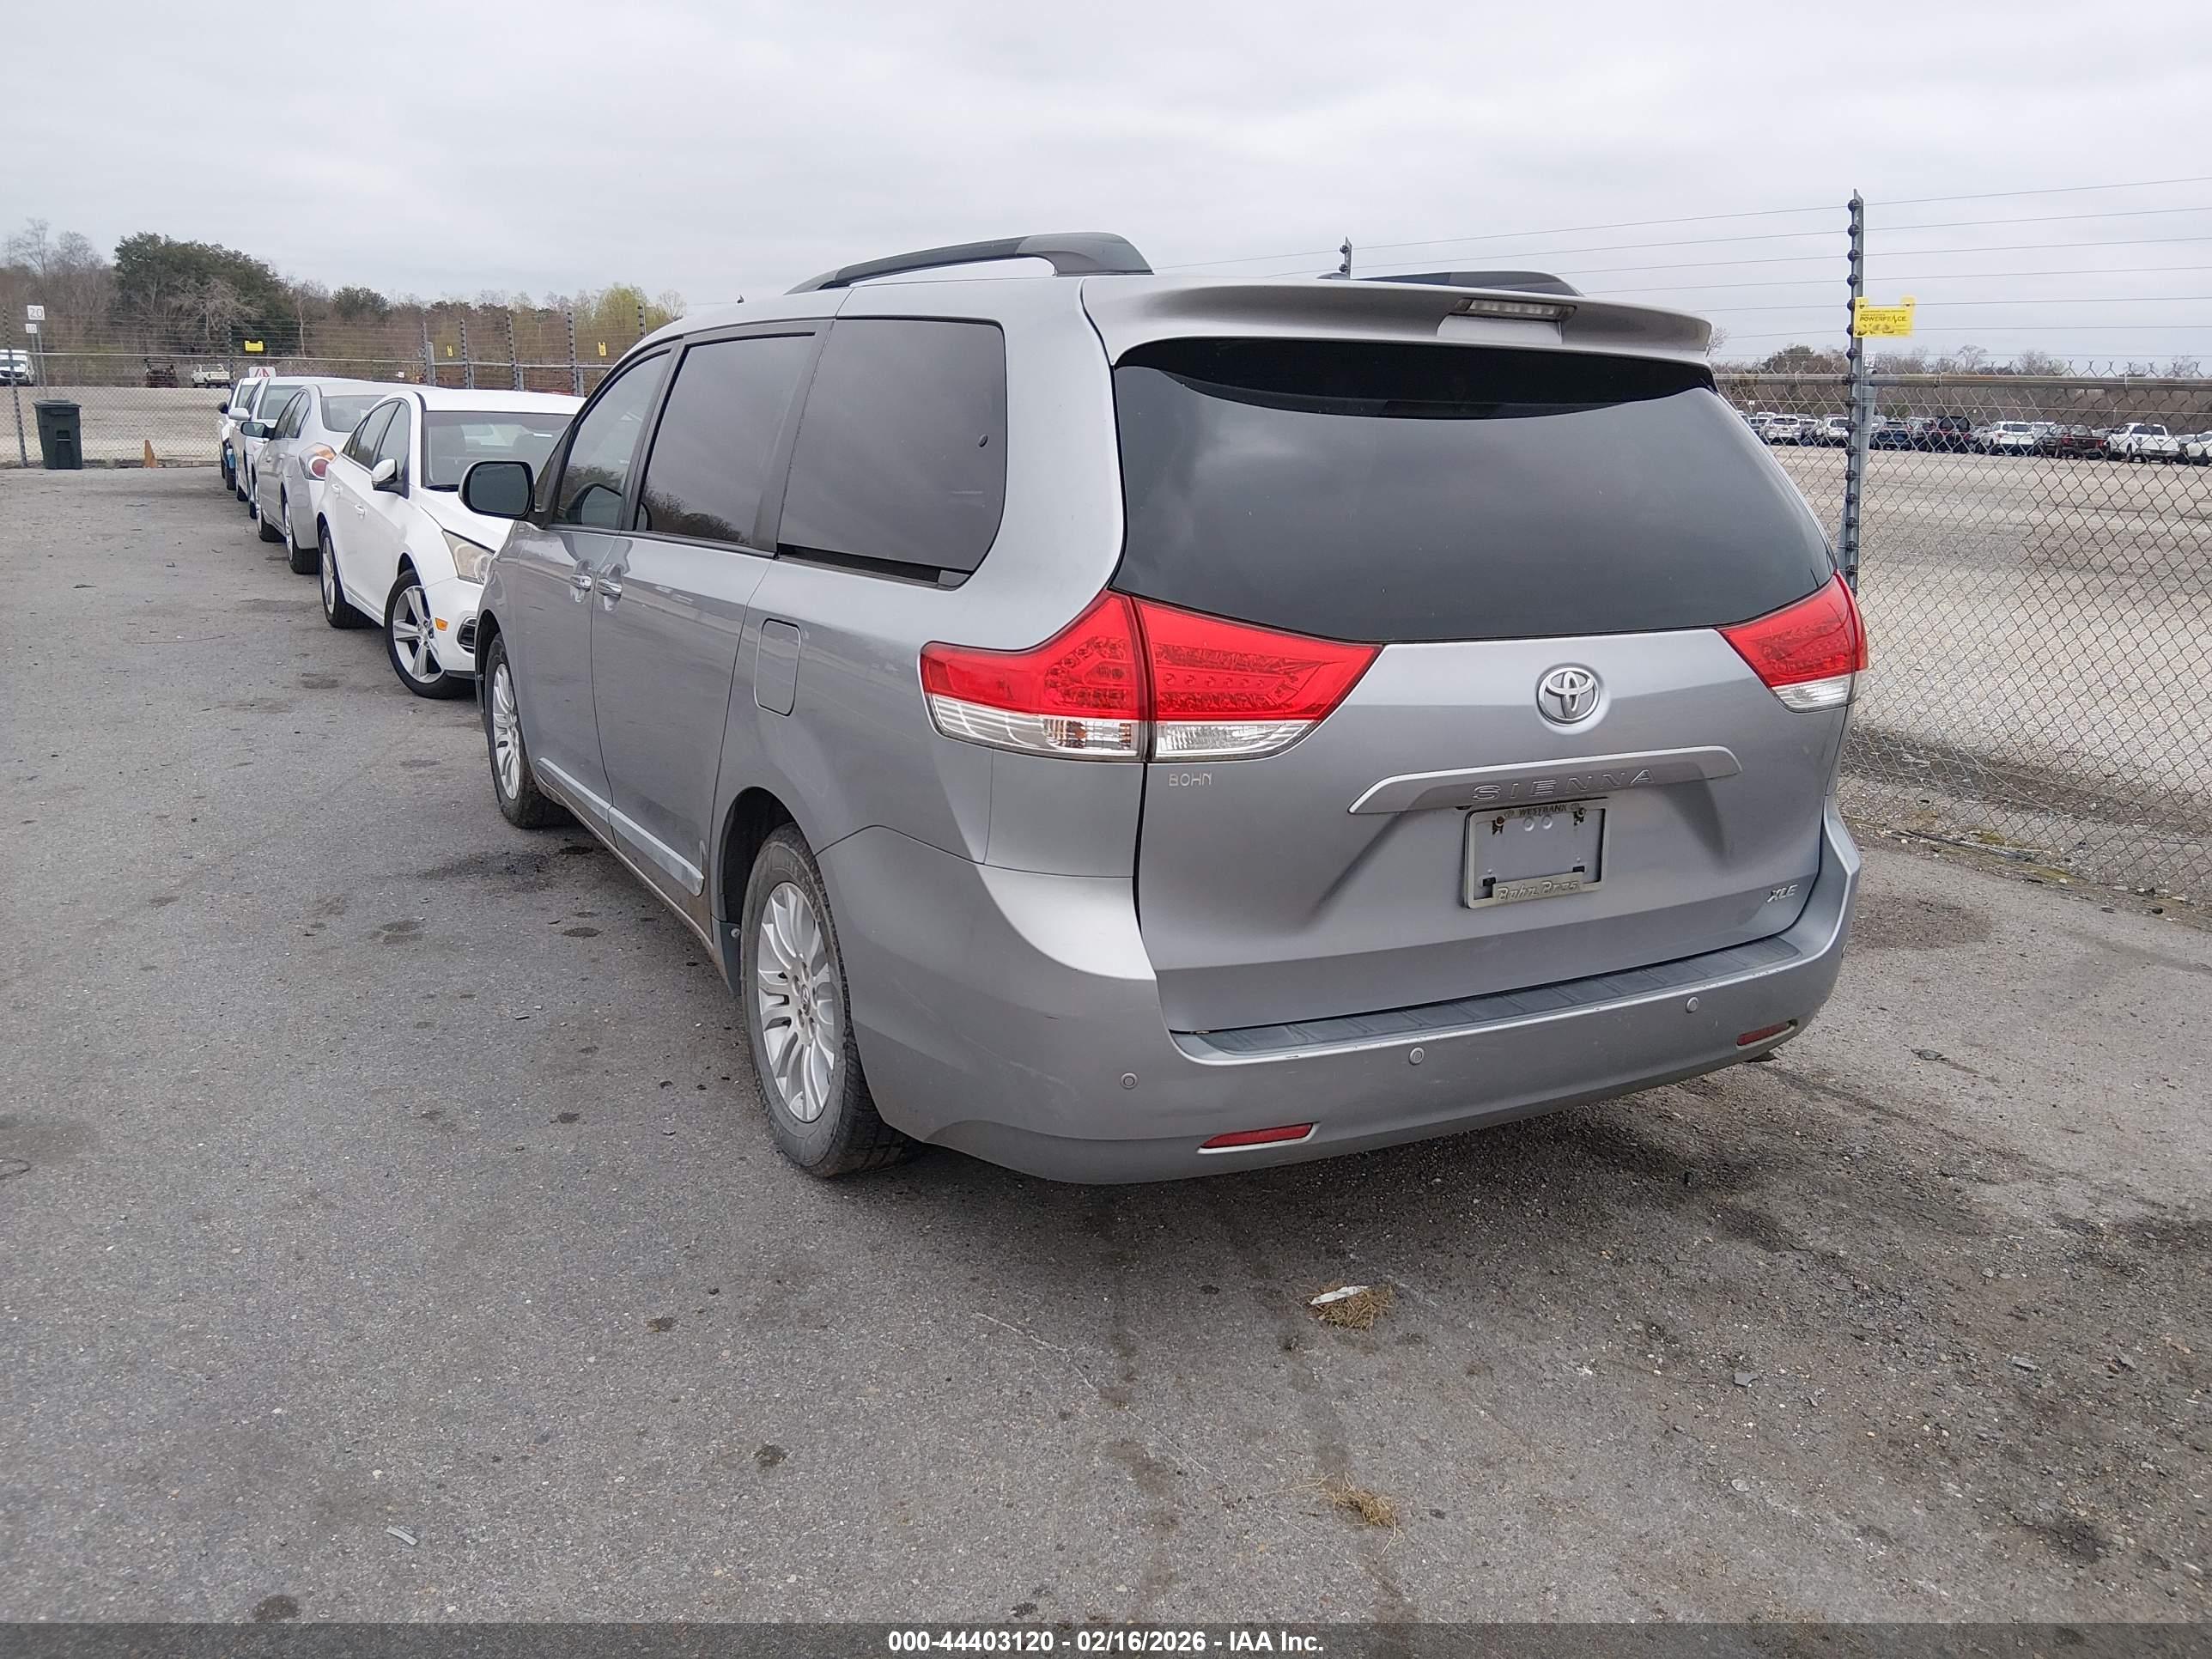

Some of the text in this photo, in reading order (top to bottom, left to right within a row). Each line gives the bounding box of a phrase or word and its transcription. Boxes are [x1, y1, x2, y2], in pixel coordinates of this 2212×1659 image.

[28, 308, 44, 318] 20
[1168, 772, 1212, 787] BOHN
[1472, 769, 1656, 802] SIENNA
[1518, 804, 1568, 817] WESTBANK
[1497, 884, 1540, 902] Bohn
[1766, 884, 1799, 902] XLE
